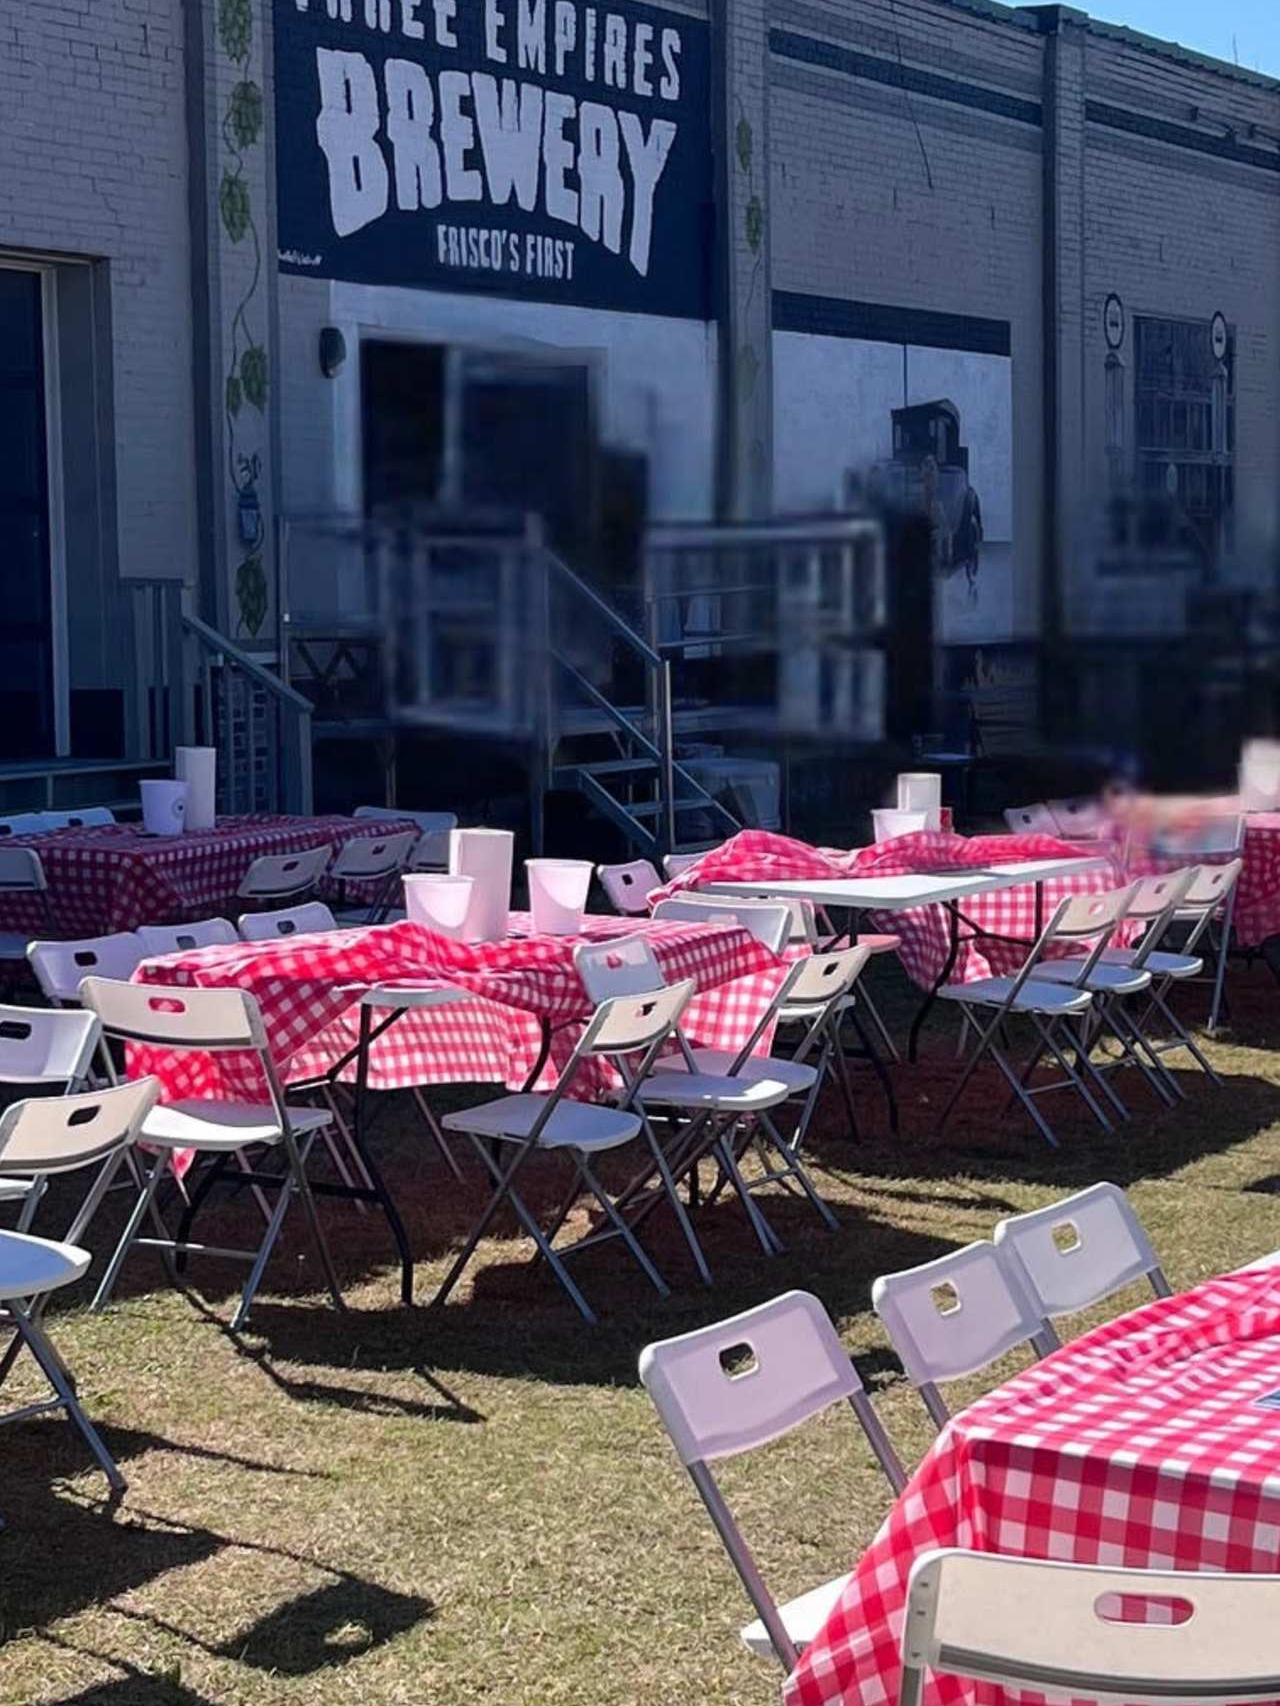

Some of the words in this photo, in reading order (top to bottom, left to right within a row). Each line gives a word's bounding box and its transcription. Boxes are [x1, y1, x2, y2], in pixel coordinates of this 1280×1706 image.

[316, 46, 677, 277] BREWERY
[437, 224, 519, 272] FRISCO'S
[525, 234, 575, 280] FIRST
